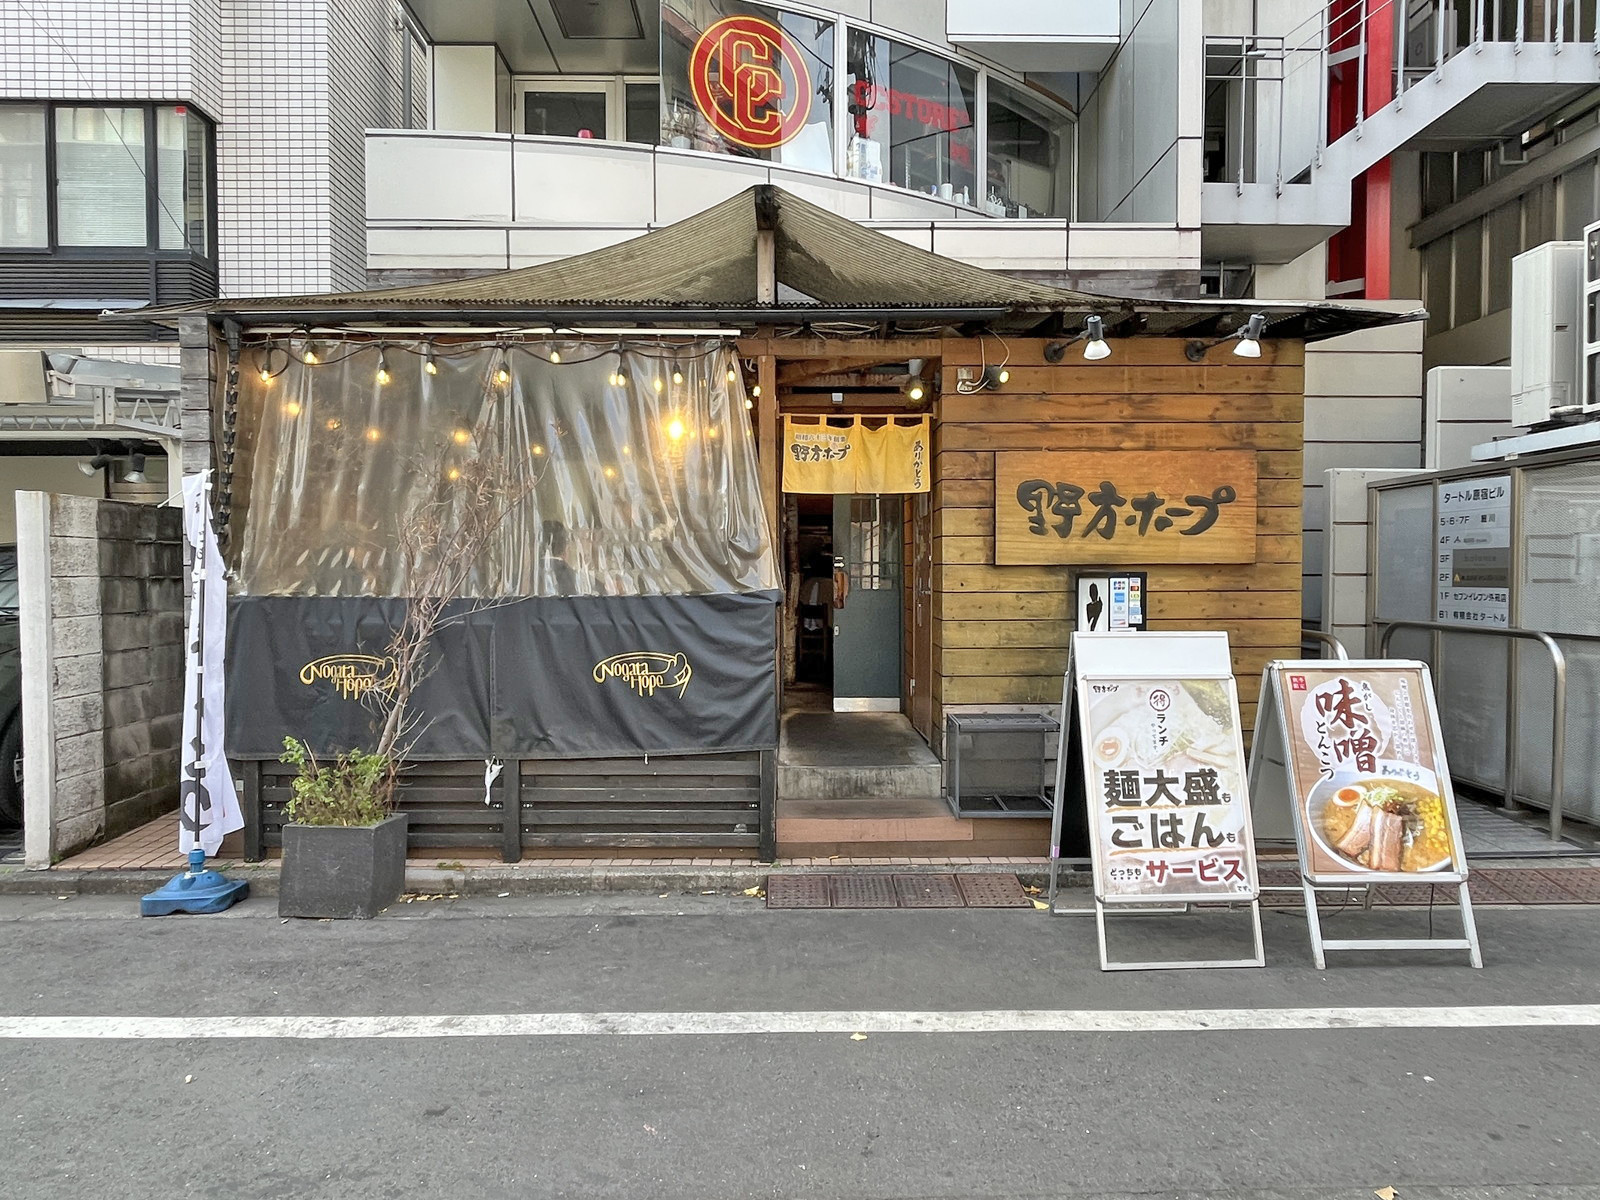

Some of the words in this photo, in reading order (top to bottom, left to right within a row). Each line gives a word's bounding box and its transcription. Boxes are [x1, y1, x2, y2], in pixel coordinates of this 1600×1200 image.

[790, 444, 851, 462] 野方ホープ
[1444, 486, 1505, 504] タートル原宿ビル
[1016, 479, 1237, 540] 野方ホープ
[1440, 535, 1450, 544] 4F
[1440, 554, 1450, 563] 3F
[1439, 573, 1450, 582] 2F
[1440, 591, 1450, 600] 1F
[1439, 610, 1449, 619] B1
[597, 662, 649, 683] Nogata
[630, 674, 664, 697] Hope
[1315, 678, 1378, 774] 味噌
[1315, 720, 1335, 780] とんこつ
